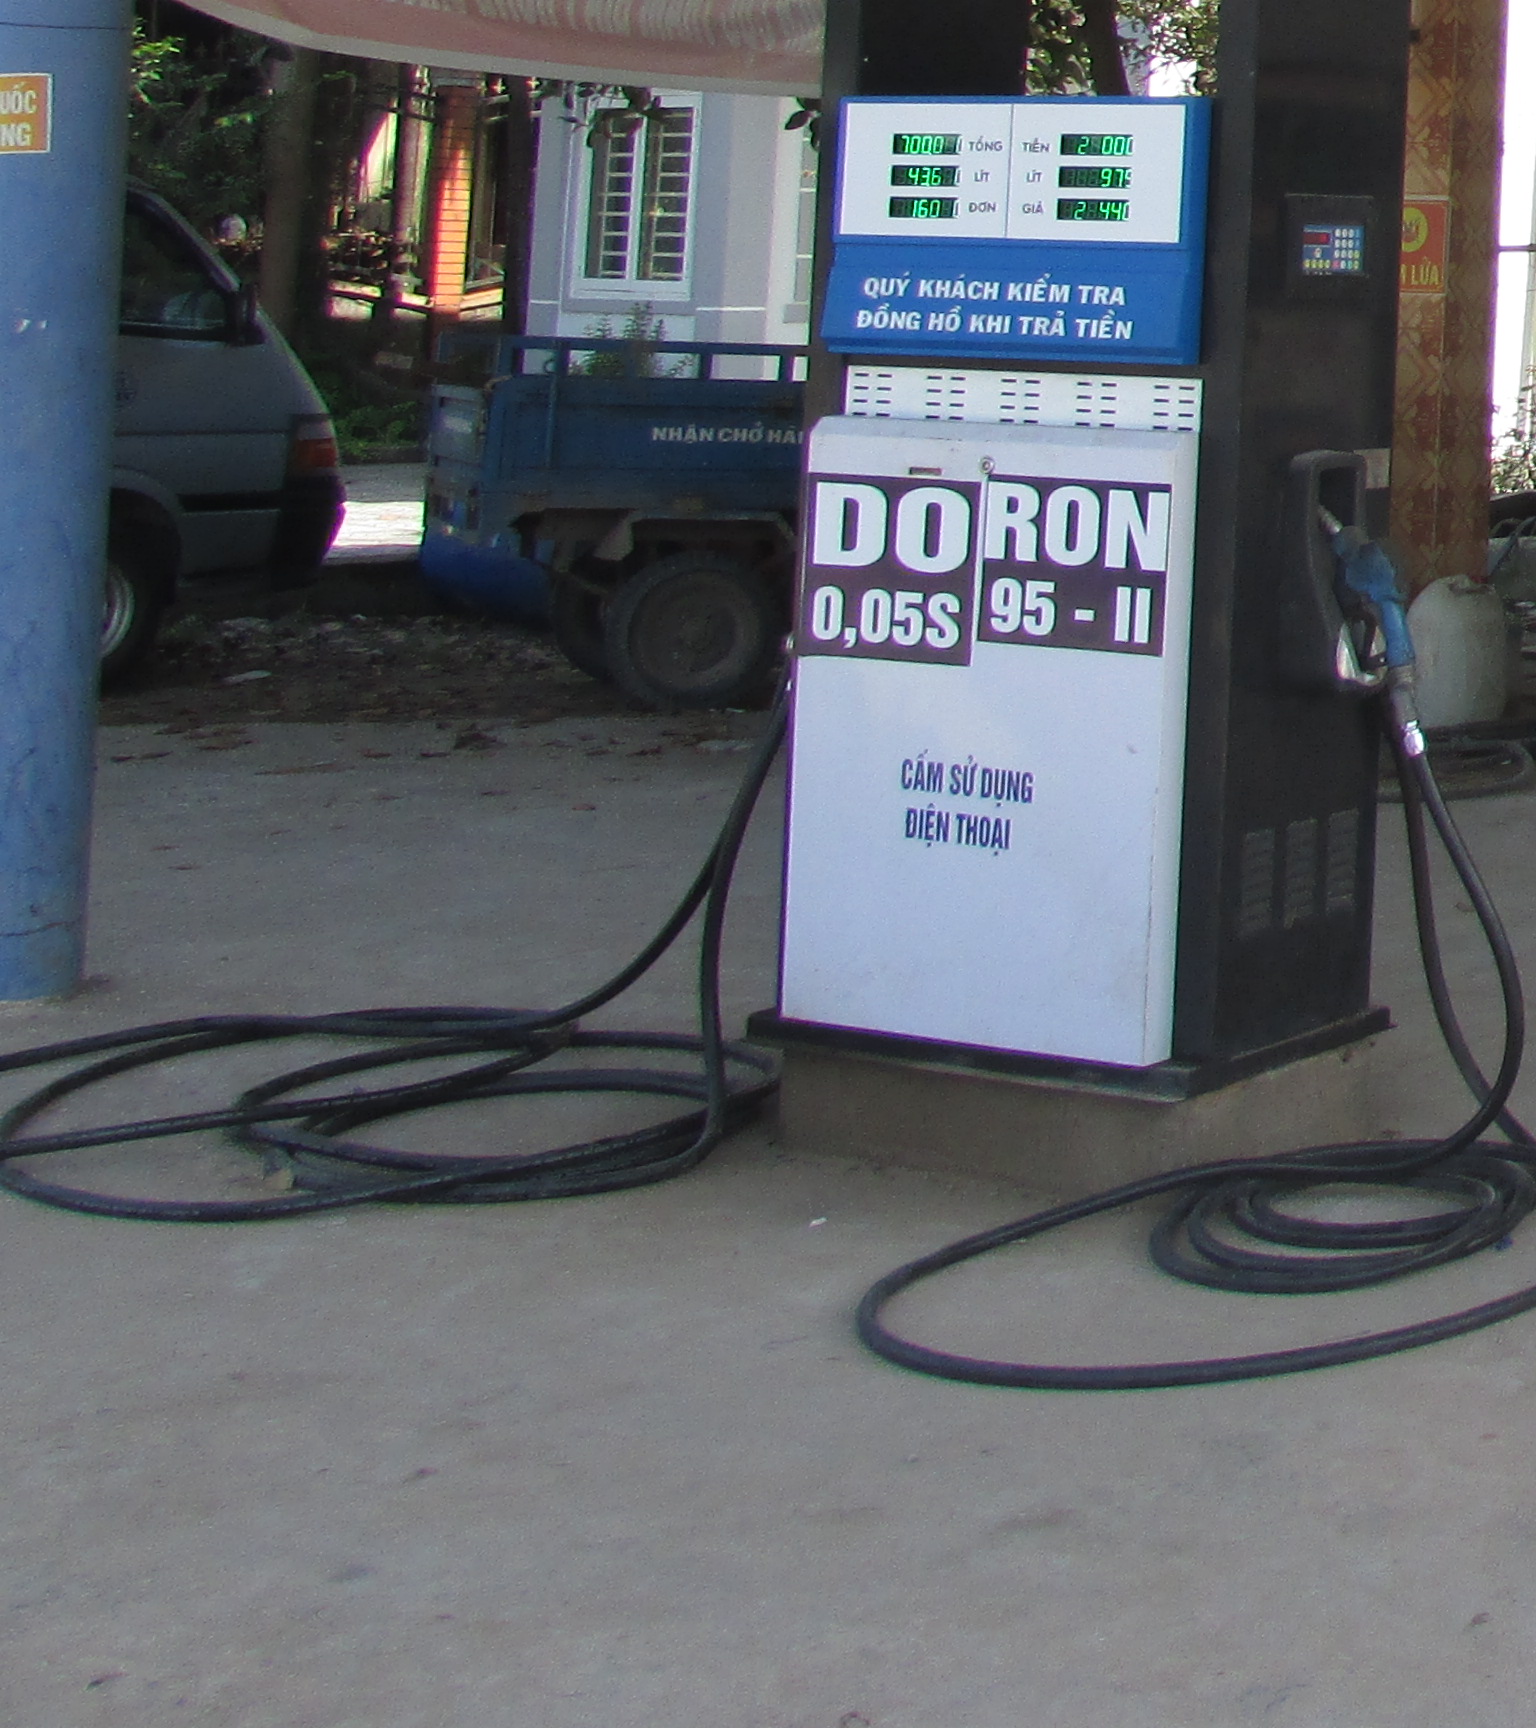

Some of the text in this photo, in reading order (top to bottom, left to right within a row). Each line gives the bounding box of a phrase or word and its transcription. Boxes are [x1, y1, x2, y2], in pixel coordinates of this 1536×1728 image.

[864, 272, 1126, 306] QUÝ KHÁCH KIỂM TRA
[856, 302, 1134, 341] ĐỒNG HỒ KHI TRẢ TIỀN
[652, 423, 715, 445] NHẬN
[811, 480, 971, 574] DO
[984, 479, 1171, 572] RON
[811, 584, 962, 650] 0,05S
[989, 577, 1057, 636] 95
[900, 749, 1035, 807] CẤM SỬ DỤNG
[905, 803, 1012, 856] ĐIỆN THOẠI
